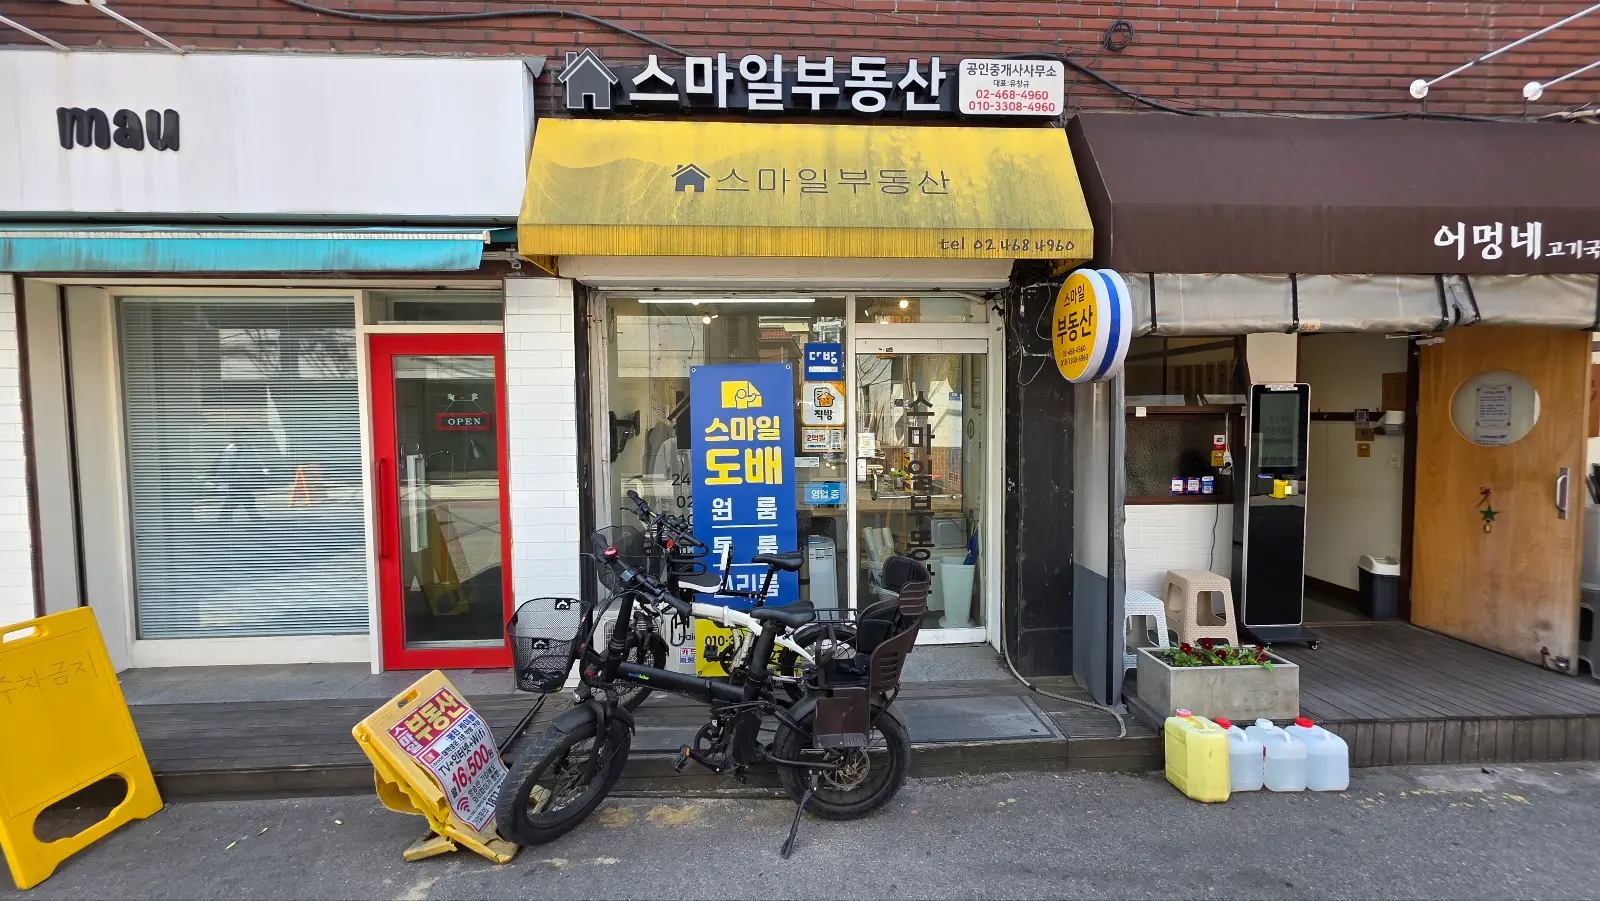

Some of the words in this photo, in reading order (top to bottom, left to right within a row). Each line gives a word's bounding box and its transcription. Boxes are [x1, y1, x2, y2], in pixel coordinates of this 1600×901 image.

[629, 52, 946, 113] 스마일부동산
[966, 62, 1057, 78] 공인중개사사무소
[968, 101, 1055, 112] 010-3308-4960
[976, 89, 1049, 100] 02-468-4960
[57, 106, 181, 152] mau
[716, 168, 950, 195] 스마일부동산
[939, 237, 965, 250] tel
[974, 239, 1076, 252] 02.468.4960
[1434, 221, 1542, 260] 어멍네
[1063, 284, 1085, 307] 스마일
[1057, 305, 1093, 344] 부동산
[809, 351, 838, 365] 다방
[448, 418, 481, 426] OPEN
[814, 409, 834, 421] 직방
[704, 415, 781, 441] 스마일
[704, 446, 783, 486] 도배
[811, 488, 829, 500] 영업
[830, 489, 840, 500] 중
[907, 391, 935, 594] 스마일부동
[712, 497, 732, 521] 원
[756, 496, 777, 520] 룸
[404, 691, 466, 741] 부동산
[393, 726, 423, 754] 스마일
